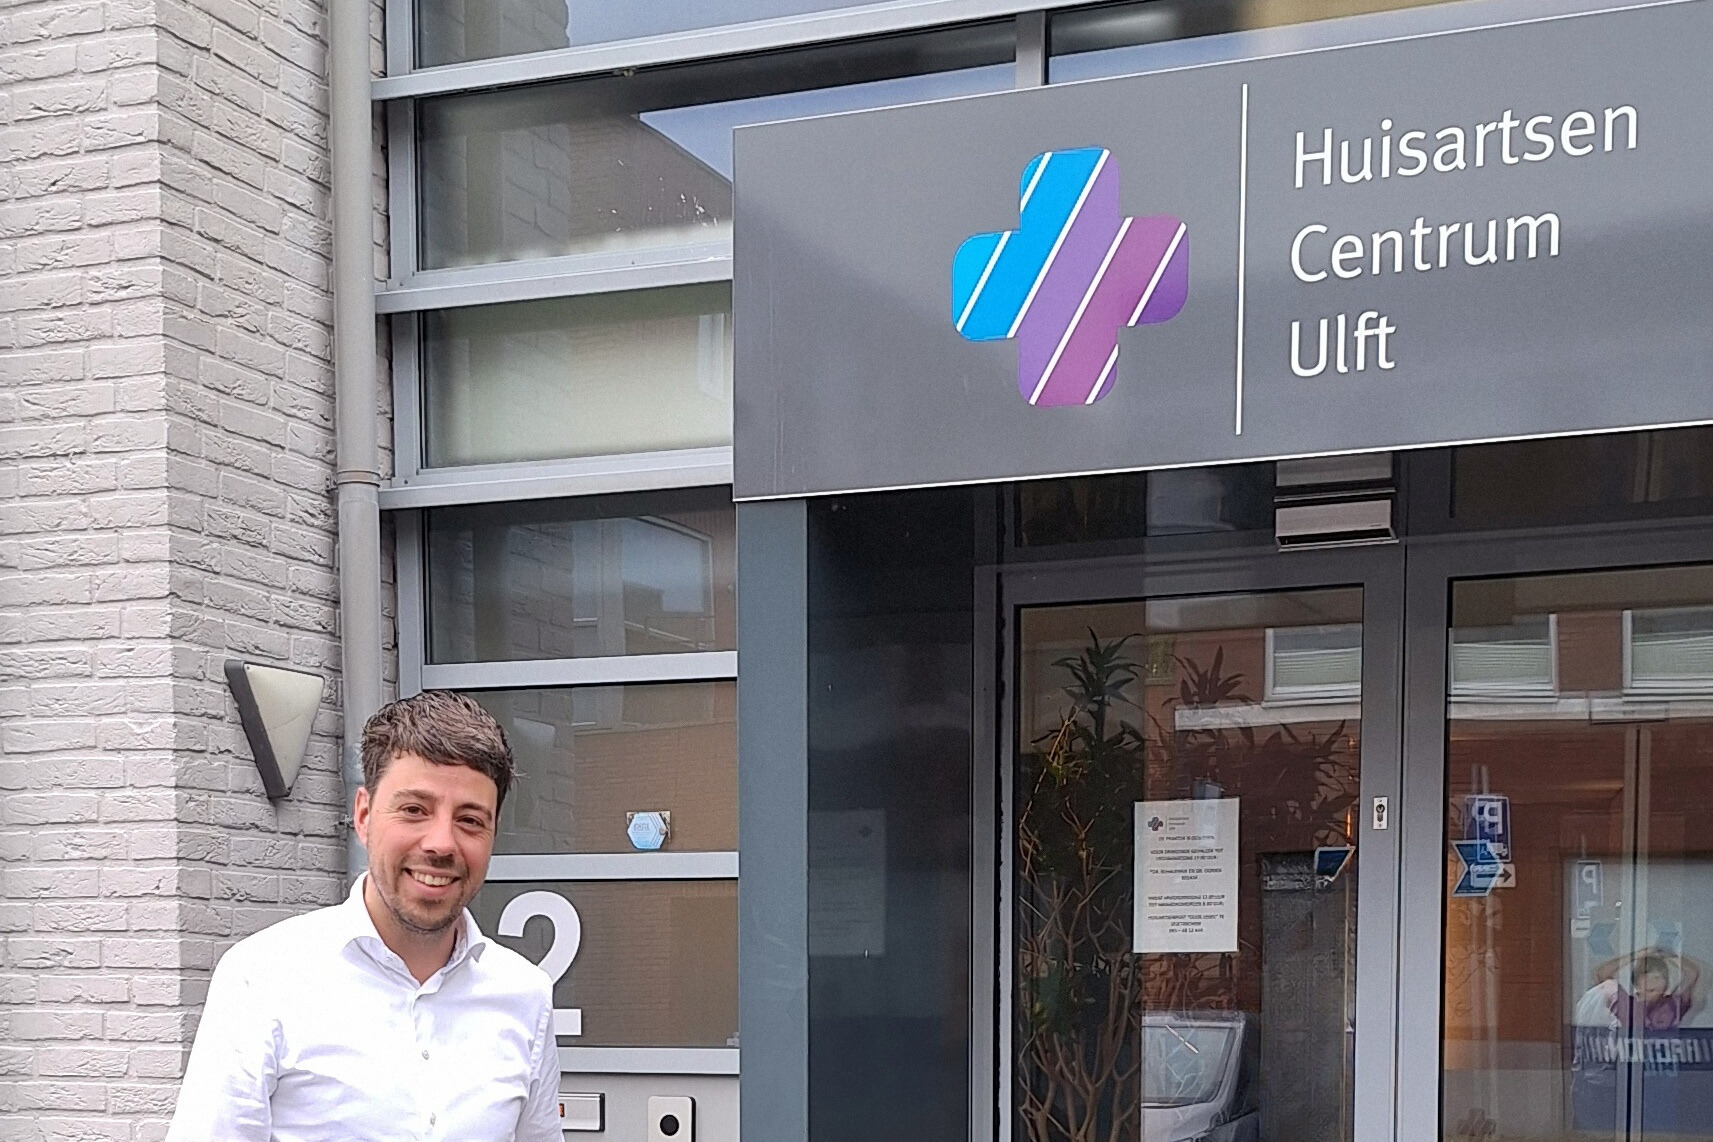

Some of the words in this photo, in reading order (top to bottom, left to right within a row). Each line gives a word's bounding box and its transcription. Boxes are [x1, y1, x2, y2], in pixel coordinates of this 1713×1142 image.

[1294, 104, 1638, 190] Huisartsen
[1290, 212, 1561, 283] Centrum
[1290, 310, 1397, 378] Ulft
[496, 890, 582, 1036] 2
